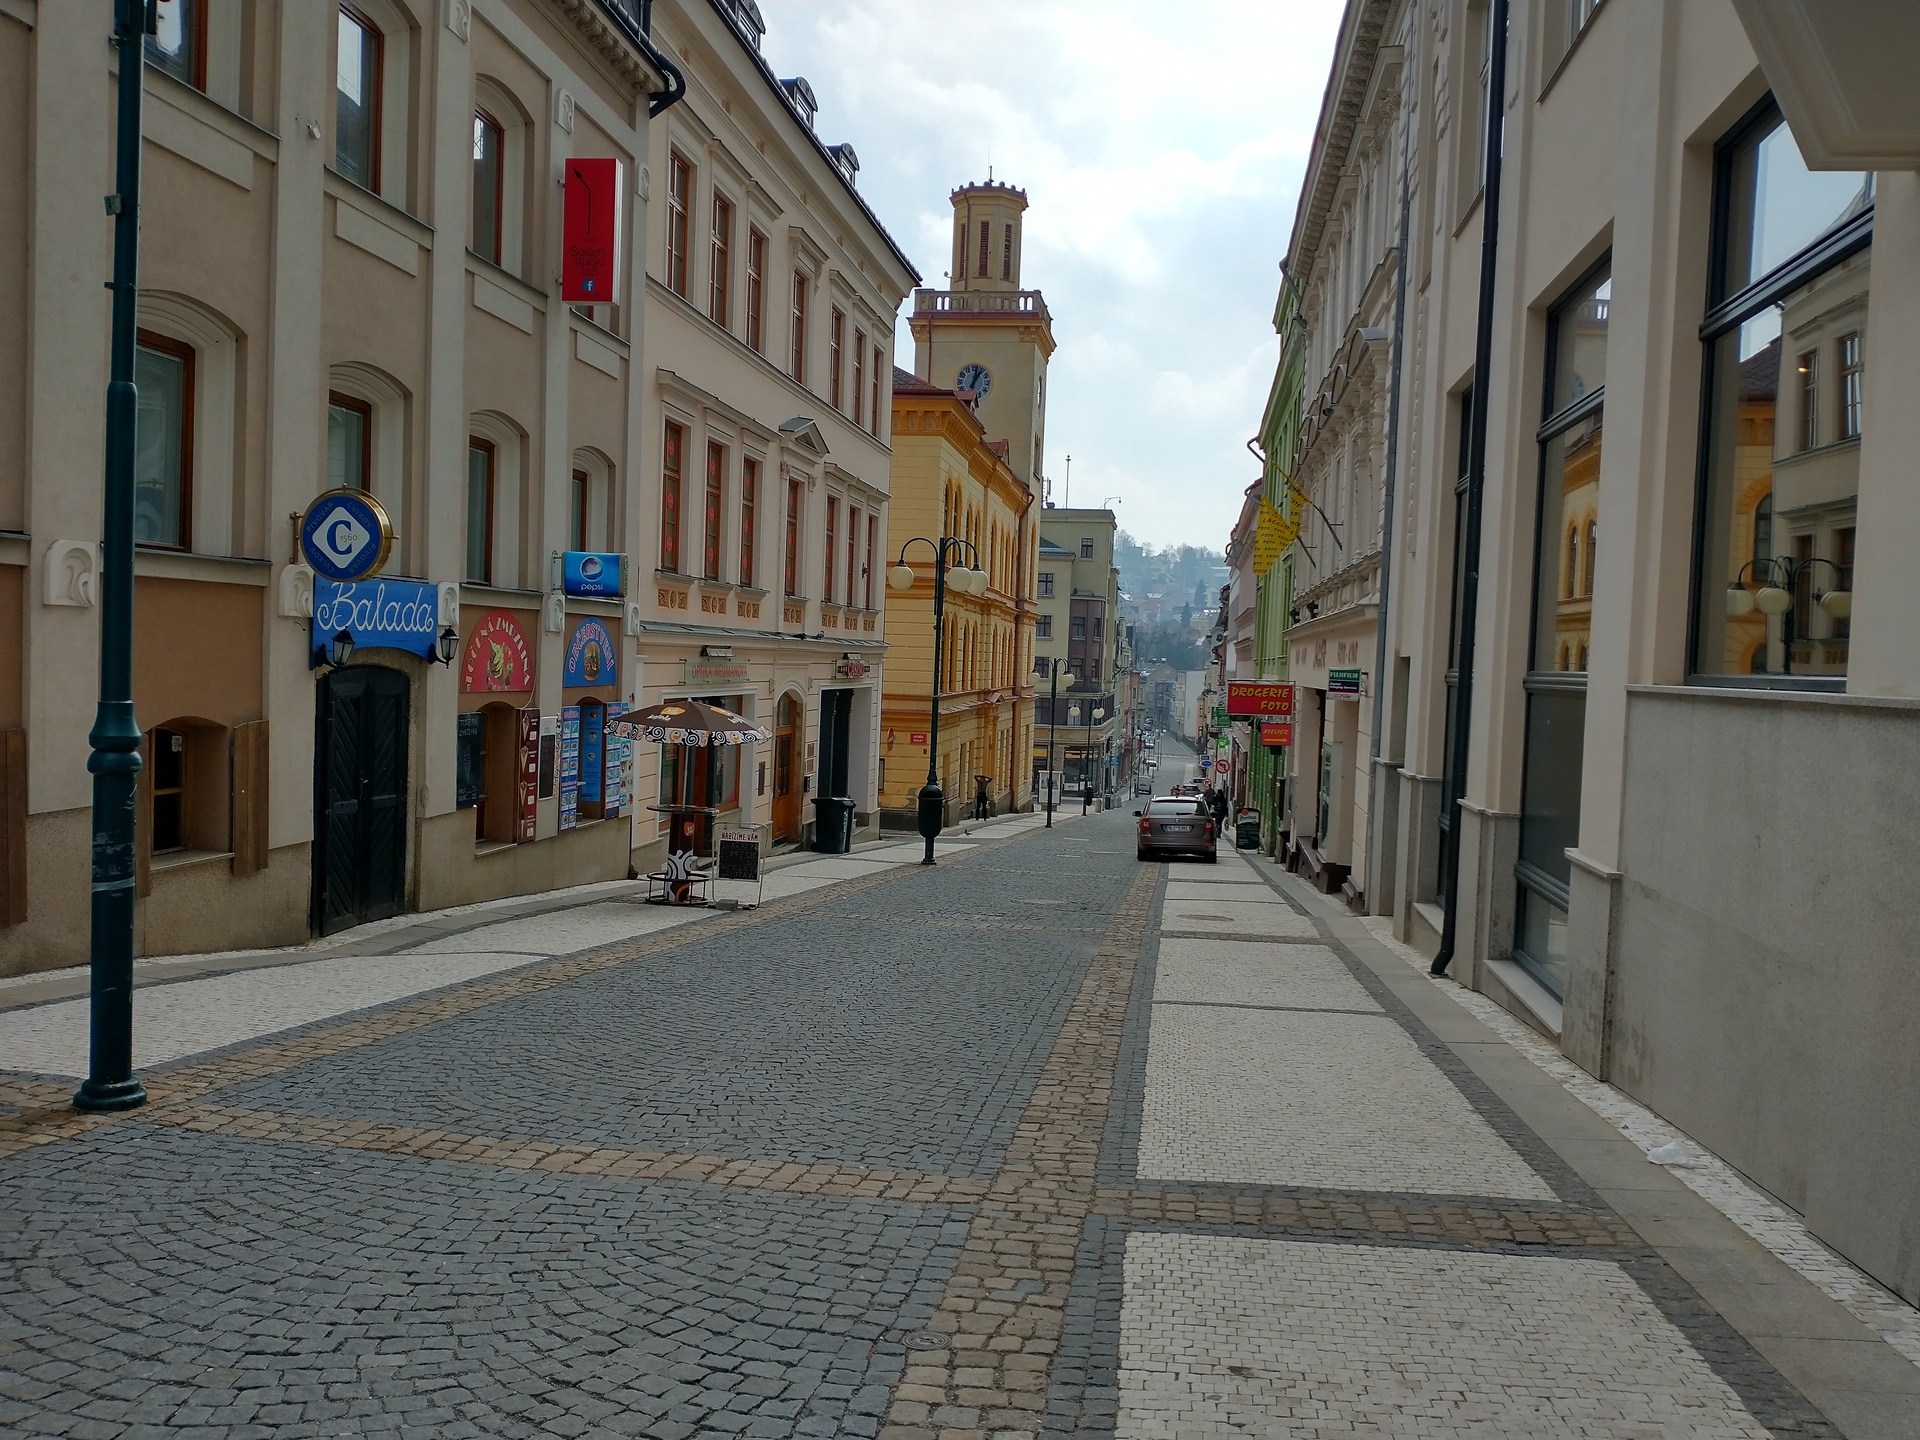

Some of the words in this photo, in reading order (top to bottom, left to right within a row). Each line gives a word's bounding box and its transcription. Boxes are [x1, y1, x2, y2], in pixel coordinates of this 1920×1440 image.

[306, 501, 335, 533] PIVOVAR
[347, 502, 374, 529] CVIKOV
[326, 519, 353, 555] C
[340, 533, 358, 543] 1560
[309, 547, 335, 573] CVIKOV
[349, 543, 377, 574] PIVOVAR
[580, 583, 604, 591] pepsi
[317, 581, 434, 633] Balada
[692, 665, 712, 678] OPTIKA
[1330, 671, 1359, 679] FUJIFILM
[1231, 686, 1290, 698] DROGERIE
[1260, 700, 1290, 711] FOTO
[721, 831, 746, 841] NABÍZÍME
[748, 832, 759, 841] VÁM
